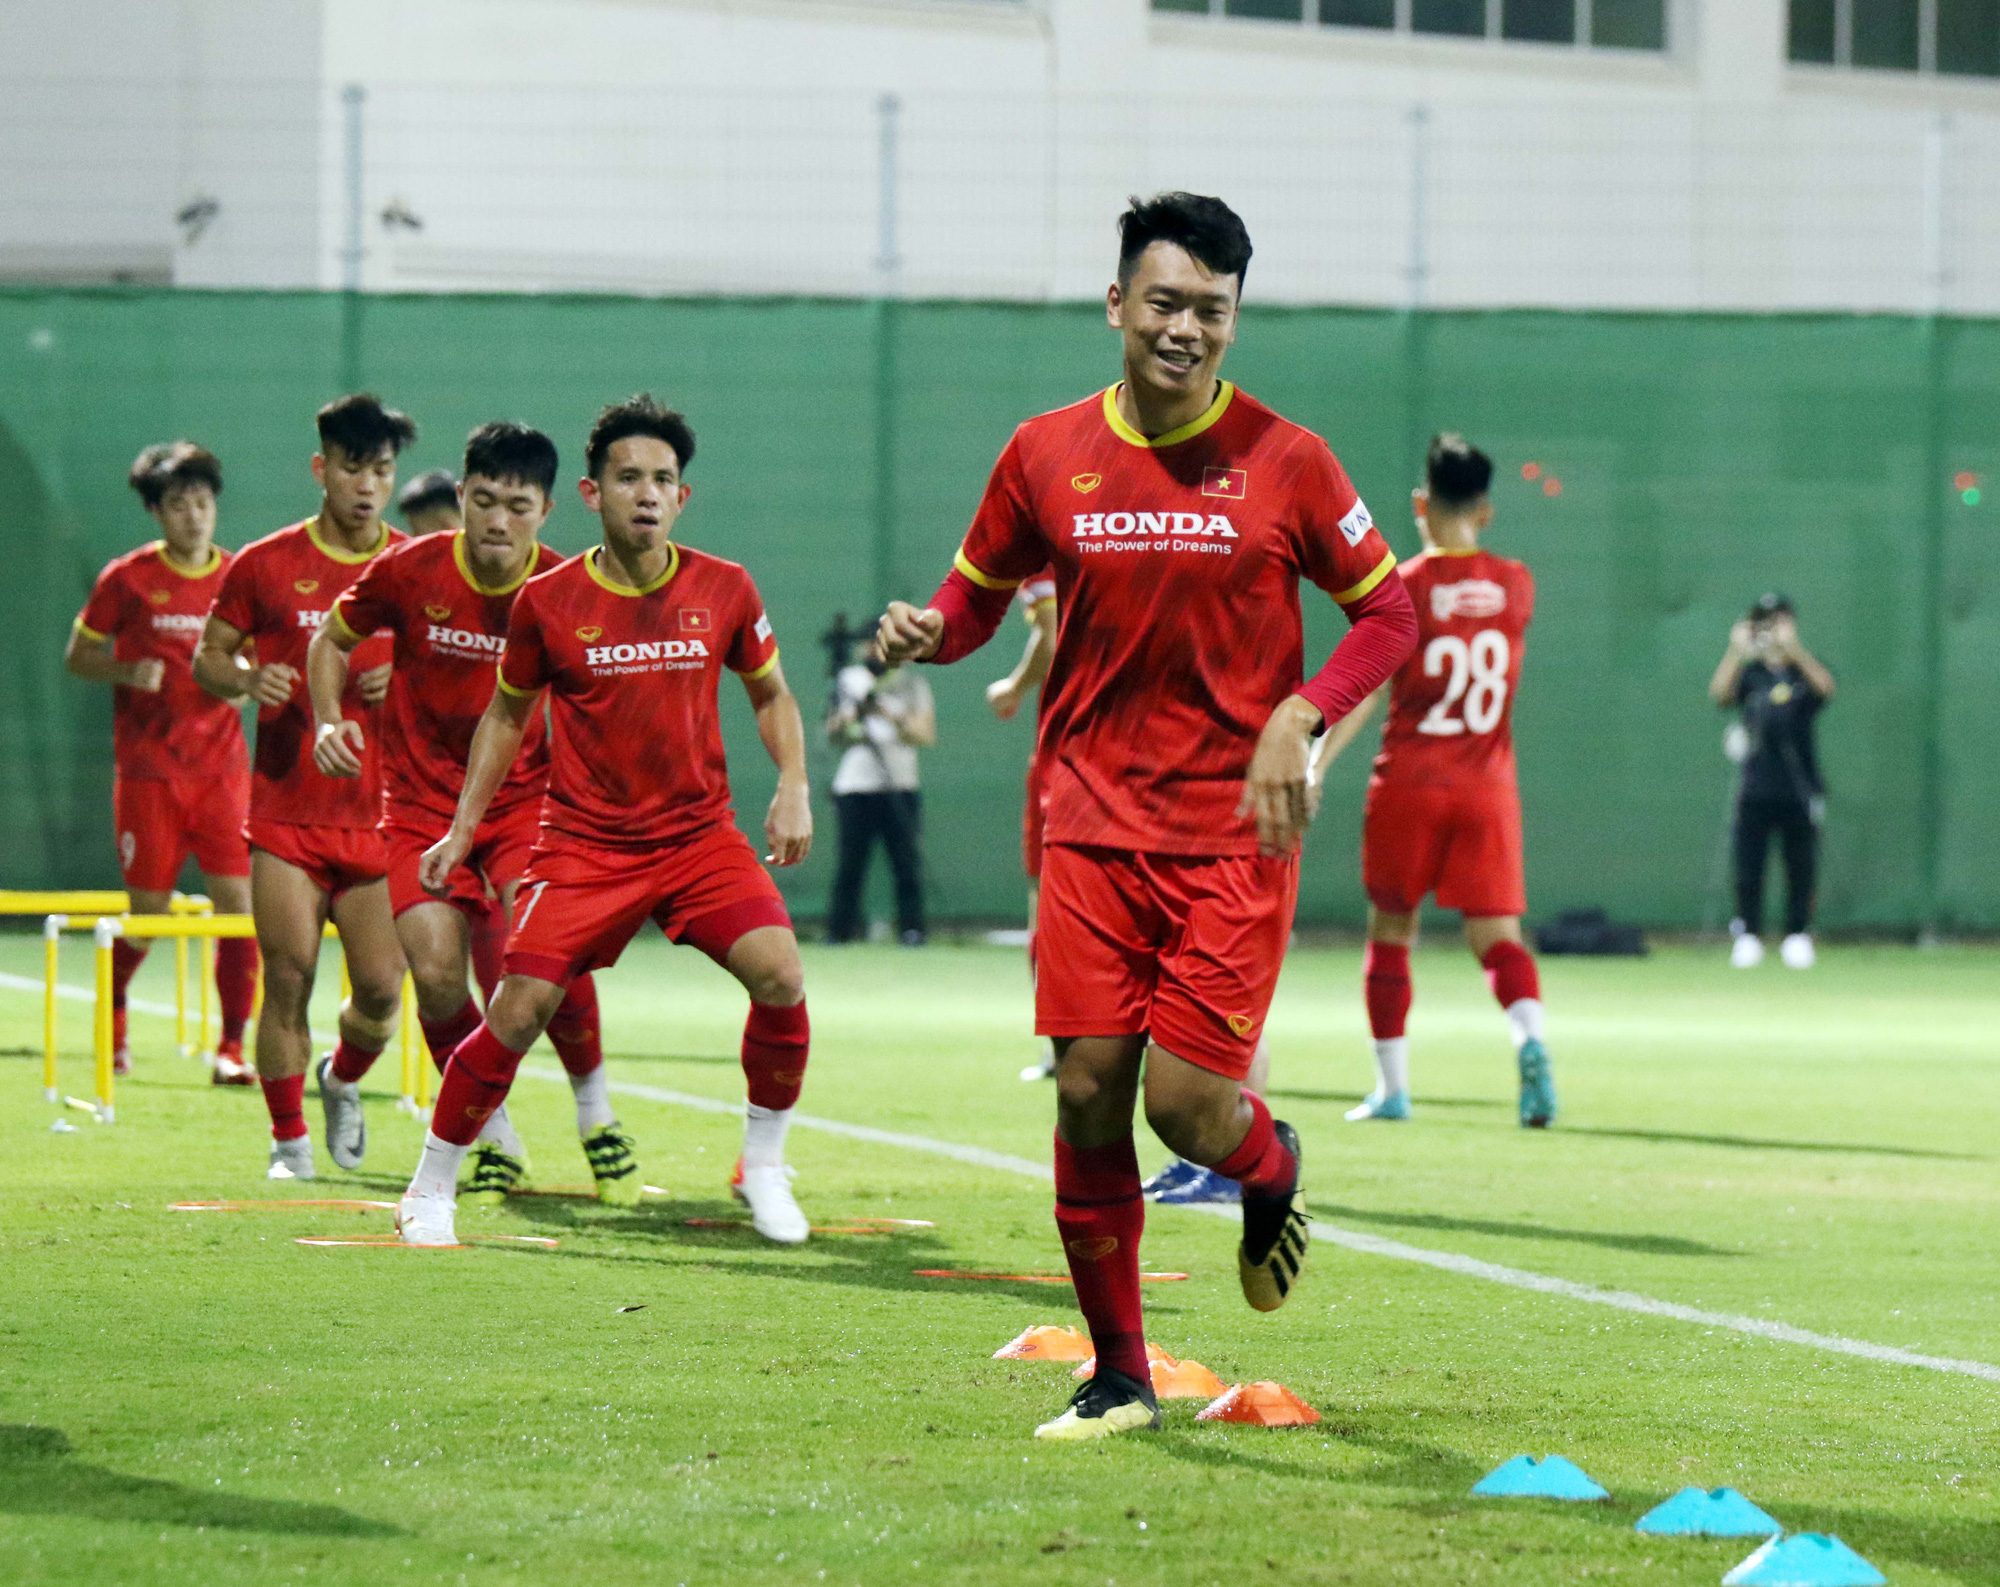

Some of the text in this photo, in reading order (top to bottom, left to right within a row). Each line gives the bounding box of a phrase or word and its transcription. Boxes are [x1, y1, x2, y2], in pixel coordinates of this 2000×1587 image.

[1072, 511, 1239, 538] HONDA
[1077, 538, 1232, 555] The Power of Dreams
[427, 624, 507, 653] HON
[585, 639, 710, 665] HONDA
[614, 664, 650, 675] Power
[651, 662, 663, 671] of
[665, 660, 705, 671] Dreams
[1418, 629, 1509, 735] 28
